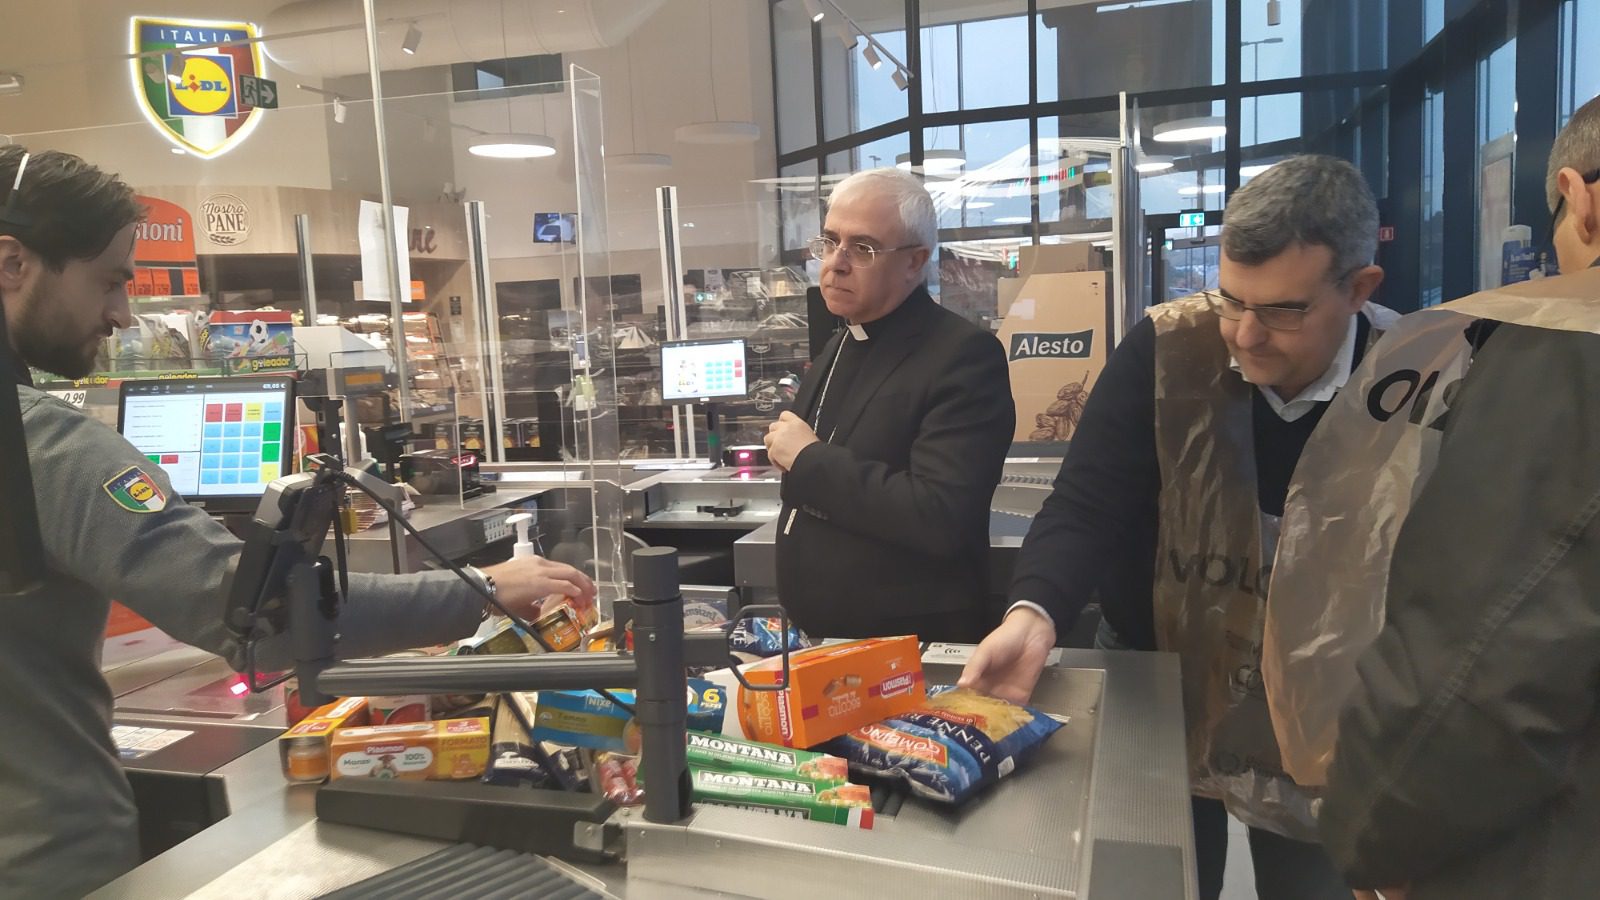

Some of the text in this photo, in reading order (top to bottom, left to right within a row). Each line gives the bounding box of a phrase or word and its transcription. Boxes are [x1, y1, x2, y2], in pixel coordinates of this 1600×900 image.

[160, 29, 231, 42] ITALIA
[206, 213, 246, 232] PANE
[1015, 336, 1084, 355] Alesto
[703, 688, 721, 703] 6
[927, 716, 992, 764] PENNE
[690, 735, 794, 765] MONTANA
[703, 772, 812, 793] MONTANA
